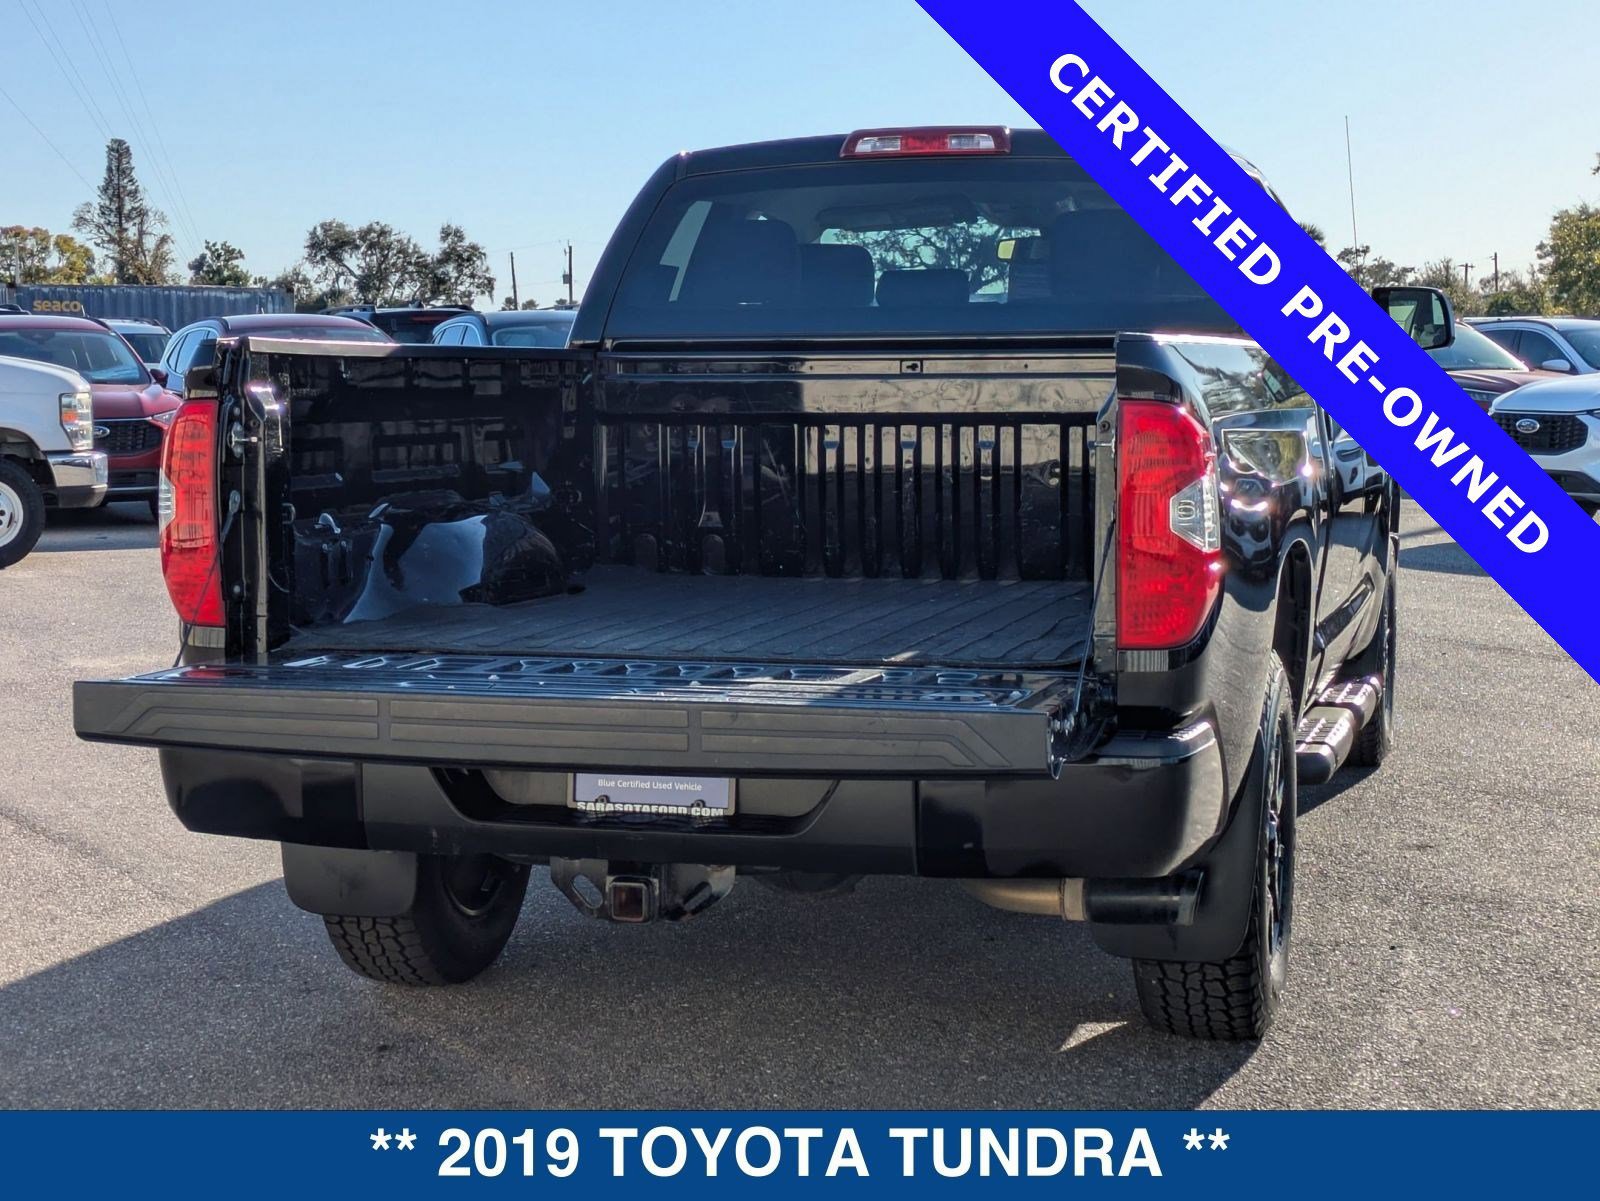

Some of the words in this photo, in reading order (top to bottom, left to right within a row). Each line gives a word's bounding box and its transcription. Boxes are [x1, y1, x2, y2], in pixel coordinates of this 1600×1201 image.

[33, 300, 81, 312] seaco
[598, 779, 616, 788] Blue
[617, 780, 650, 790] Certified
[652, 781, 673, 790] Used
[674, 782, 703, 792] Vehicle
